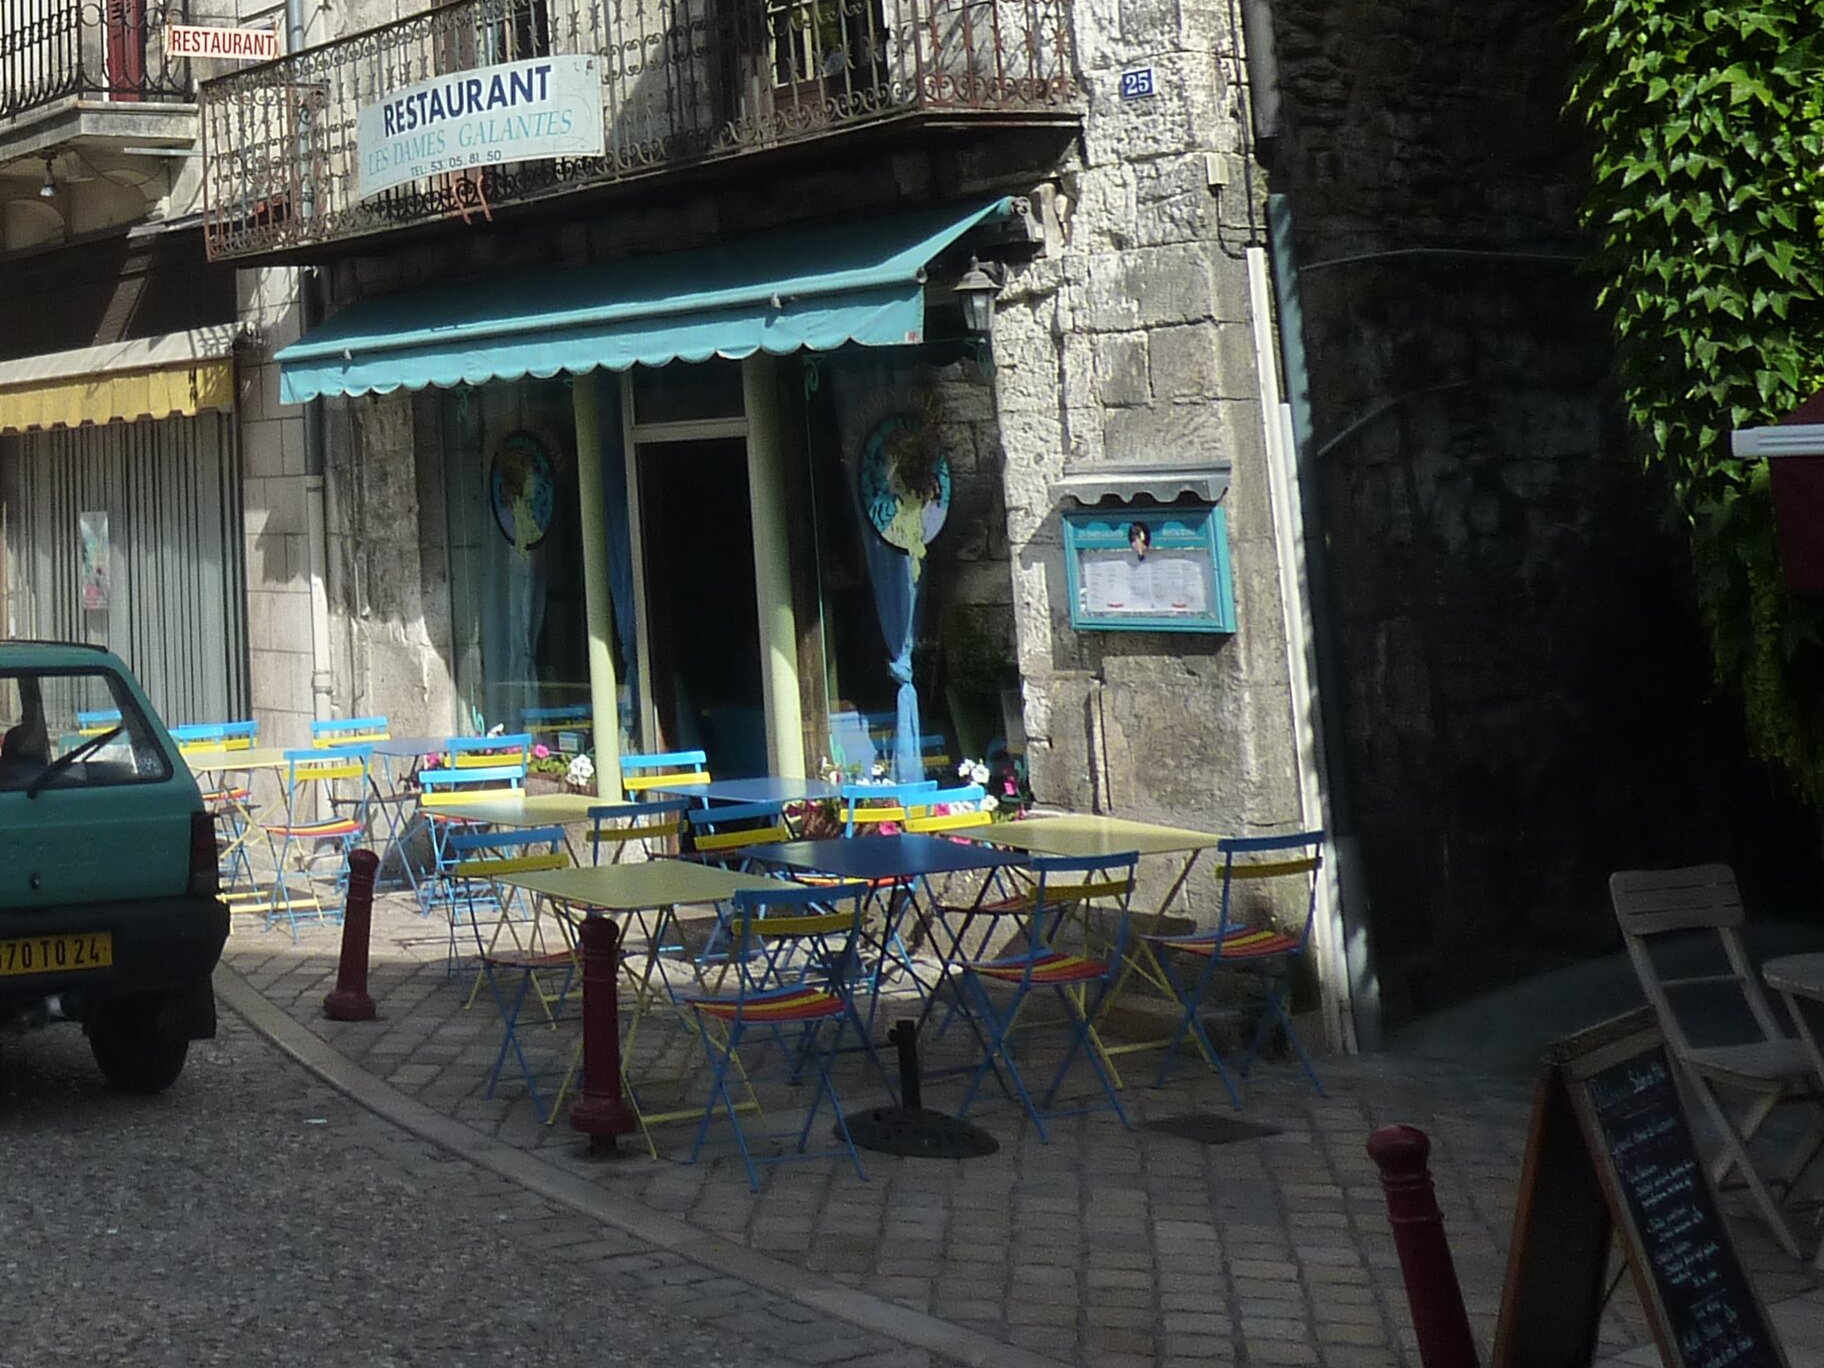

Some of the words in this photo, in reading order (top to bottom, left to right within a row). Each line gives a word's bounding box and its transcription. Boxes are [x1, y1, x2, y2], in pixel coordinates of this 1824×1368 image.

[172, 30, 274, 56] RESTAURANT
[1126, 71, 1150, 95] 25
[384, 64, 551, 137] RESTAURANT
[368, 145, 390, 176] LES
[393, 129, 446, 164] DAMES
[458, 109, 573, 148] GALANTES
[486, 150, 502, 162] 50
[74, 937, 100, 964] 24
